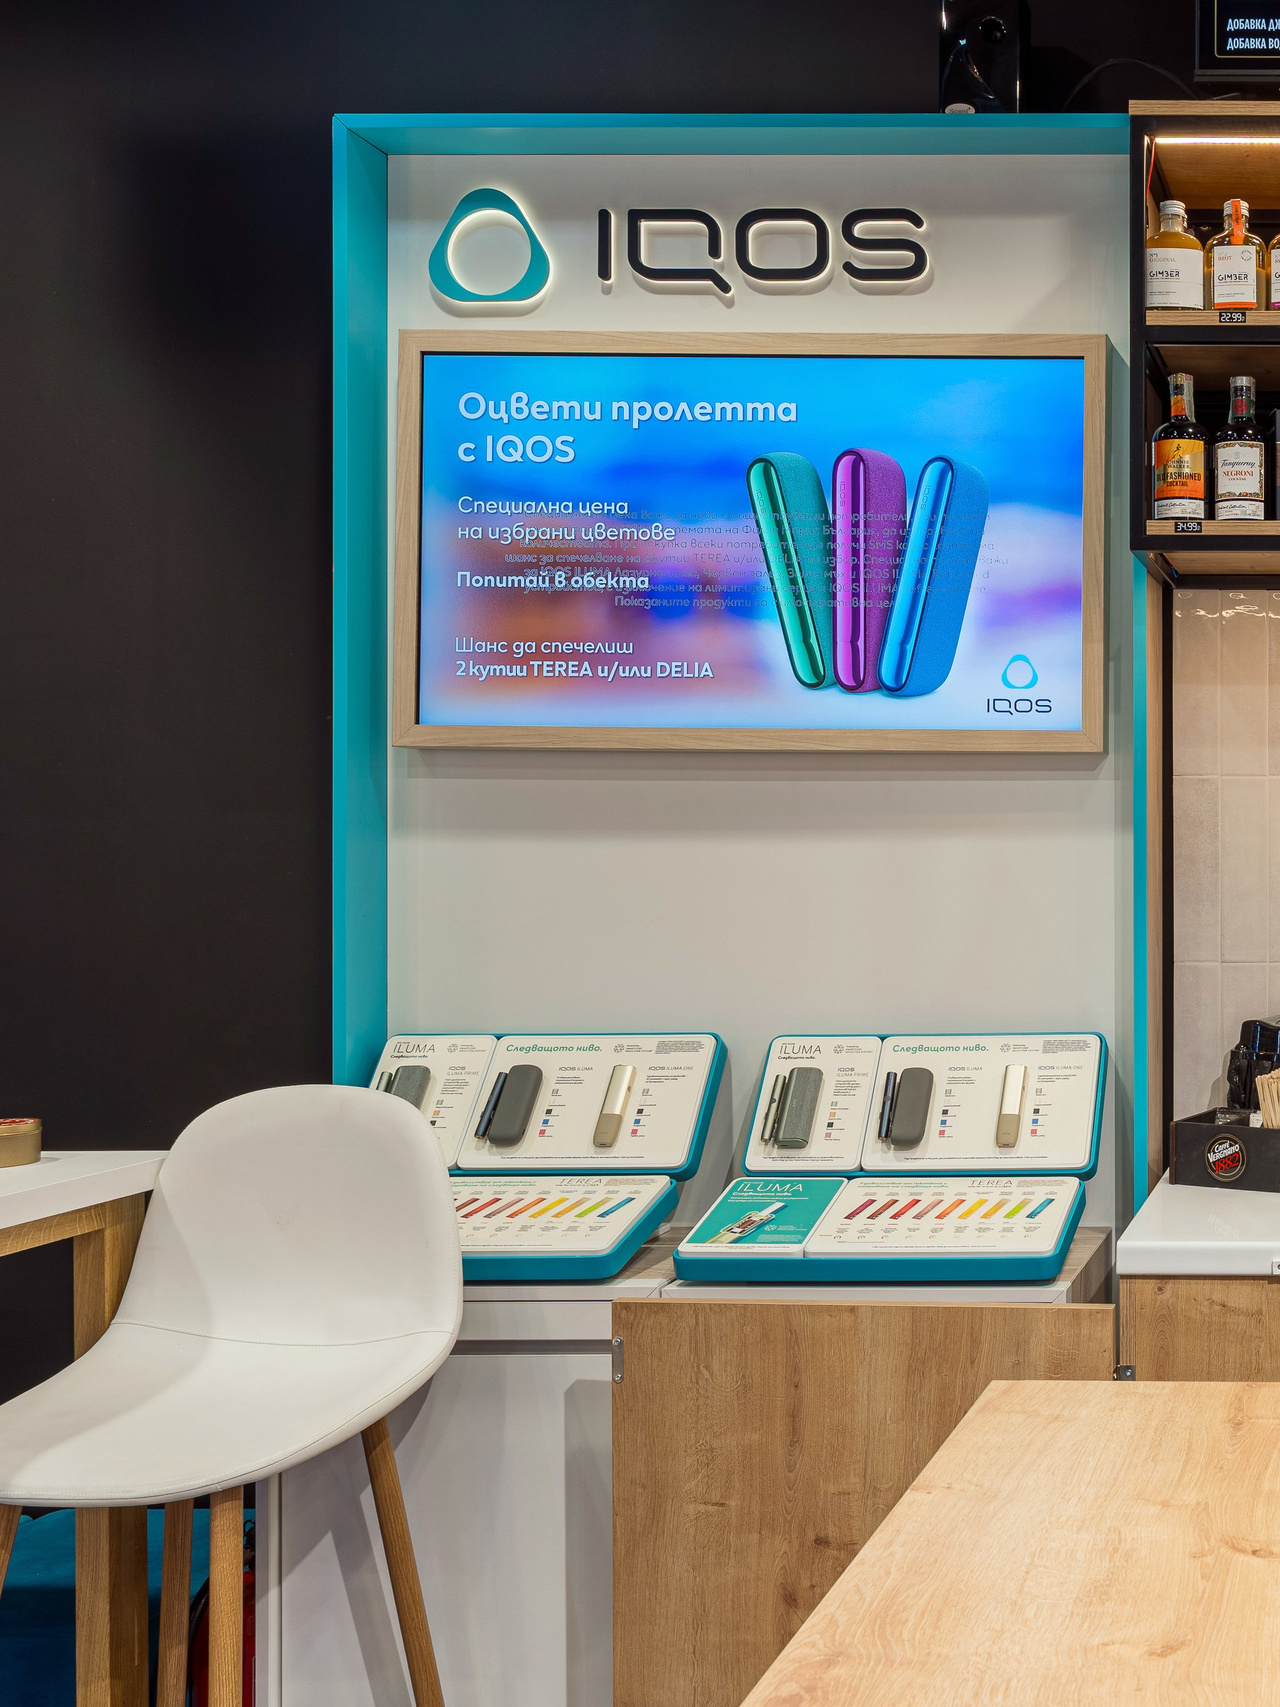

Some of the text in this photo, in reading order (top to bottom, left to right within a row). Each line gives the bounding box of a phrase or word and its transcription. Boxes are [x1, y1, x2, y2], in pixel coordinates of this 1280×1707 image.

[1226, 18, 1266, 31] ДОБАВКА
[1226, 37, 1266, 51] ДОБАВКА
[598, 208, 928, 295] IQOS
[1149, 270, 1181, 278] GIMBER
[1217, 273, 1249, 282] GIMBER
[458, 390, 797, 430] Оцвети пролетта
[457, 435, 576, 463] с IQOS
[1221, 459, 1256, 469] Tanqueray
[1156, 472, 1202, 482] OLD FASHIONED
[458, 496, 574, 517] Специална
[578, 500, 629, 517] цена
[458, 527, 483, 541] на
[488, 524, 575, 545] избрани
[581, 523, 676, 543] цветове
[456, 570, 550, 593] Попитай
[553, 572, 566, 588] в
[571, 571, 650, 589] обекта
[455, 637, 633, 657] Шанс да спечелиш
[456, 660, 714, 683] 2 кутии TEREA и/или DELIA
[987, 698, 1052, 716] IQOS
[393, 1043, 435, 1054] ILUMA
[506, 1043, 603, 1054] Следващото ниво.
[779, 1045, 822, 1055] ILUMA
[892, 1042, 989, 1055] Следващото ниво.
[1214, 1153, 1240, 1174] 1882
[737, 1183, 804, 1192] ILUMA
